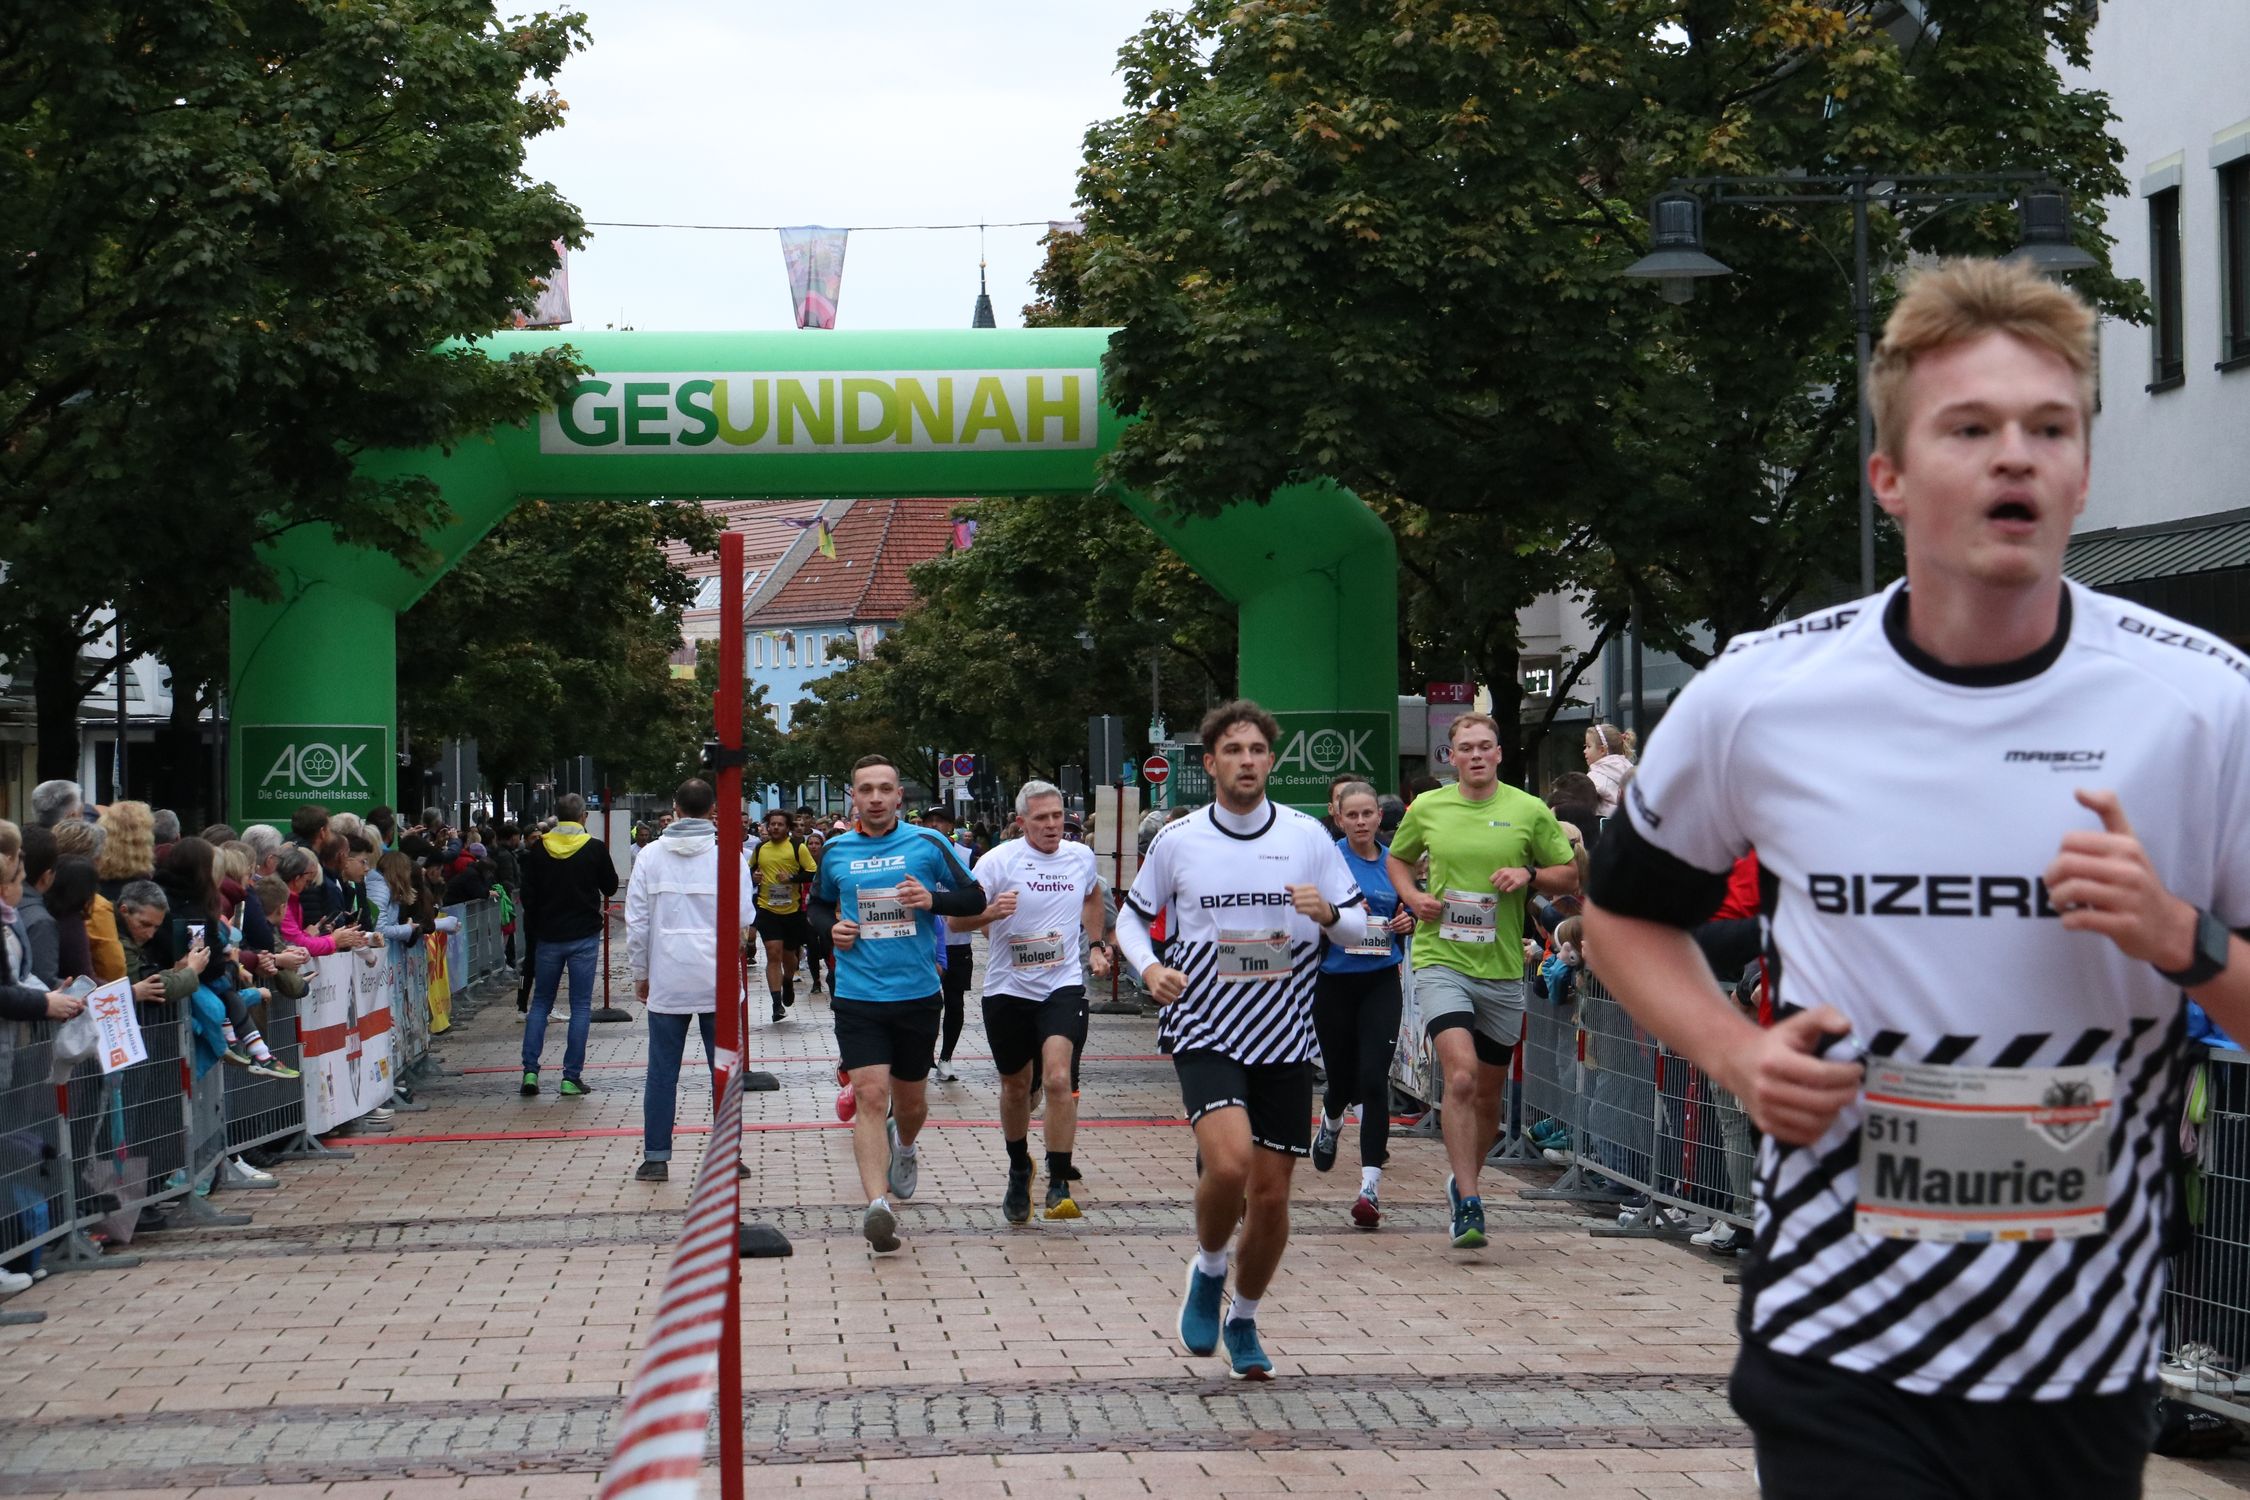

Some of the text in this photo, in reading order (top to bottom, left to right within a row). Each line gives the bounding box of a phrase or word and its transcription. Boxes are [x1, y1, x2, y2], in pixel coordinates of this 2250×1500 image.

[1271, 728, 1375, 772] AOK
[260, 743, 369, 787] AOK
[1268, 775, 1284, 785] Die
[257, 789, 273, 800] Die
[1026, 881, 1075, 892] Vantive
[859, 901, 876, 909] 2154
[866, 908, 906, 922] Jannik
[1451, 912, 1483, 926] Louis
[894, 929, 910, 937] 2154
[1219, 945, 1236, 954] 502
[1020, 950, 1056, 964] Holger
[1239, 957, 1269, 971] Tim
[1867, 1114, 1918, 1145] 511
[1876, 1153, 2085, 1206] Maurice
